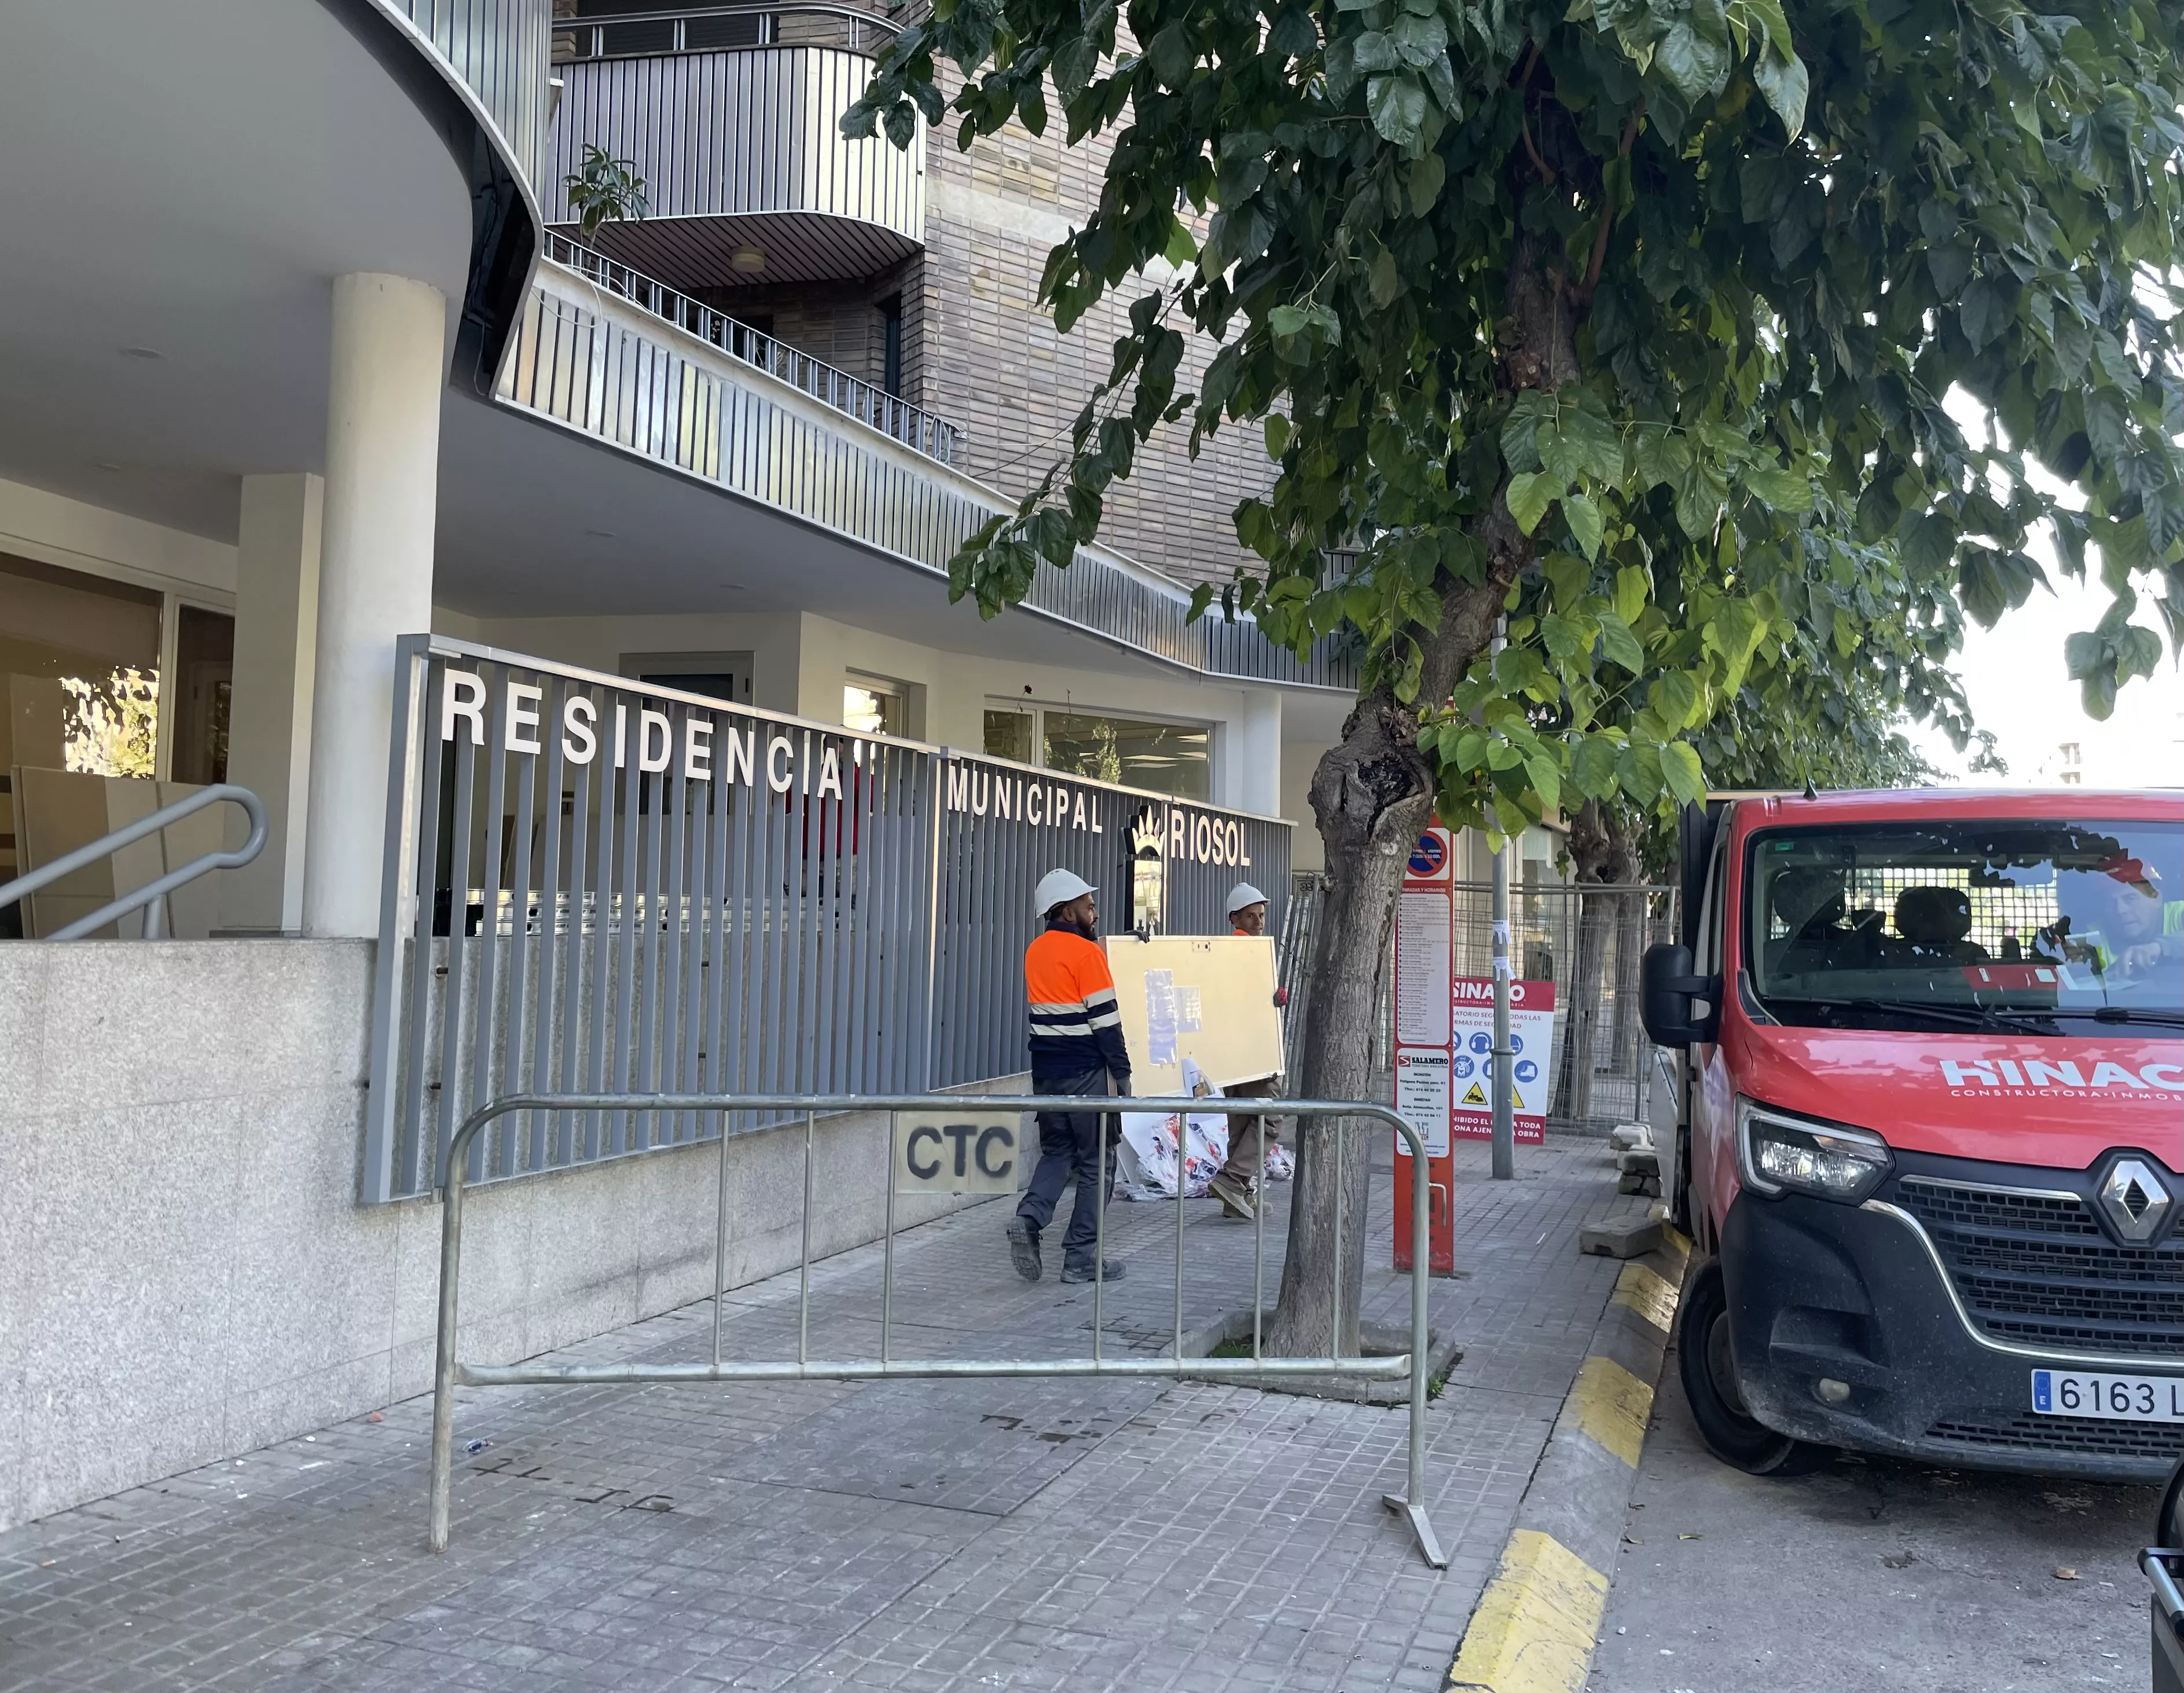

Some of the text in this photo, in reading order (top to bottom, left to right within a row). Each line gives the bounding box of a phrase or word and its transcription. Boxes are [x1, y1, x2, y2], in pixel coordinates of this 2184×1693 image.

[442, 668, 1250, 867] RESIDENCIA MUNICIPAL RIOSOL
[1412, 1057, 1448, 1065] SALAMERO
[1519, 1122, 1541, 1130] TODA
[906, 1124, 1014, 1180] CTC
[2039, 1395, 2046, 1405] E
[2060, 1378, 2155, 1414] 6163
